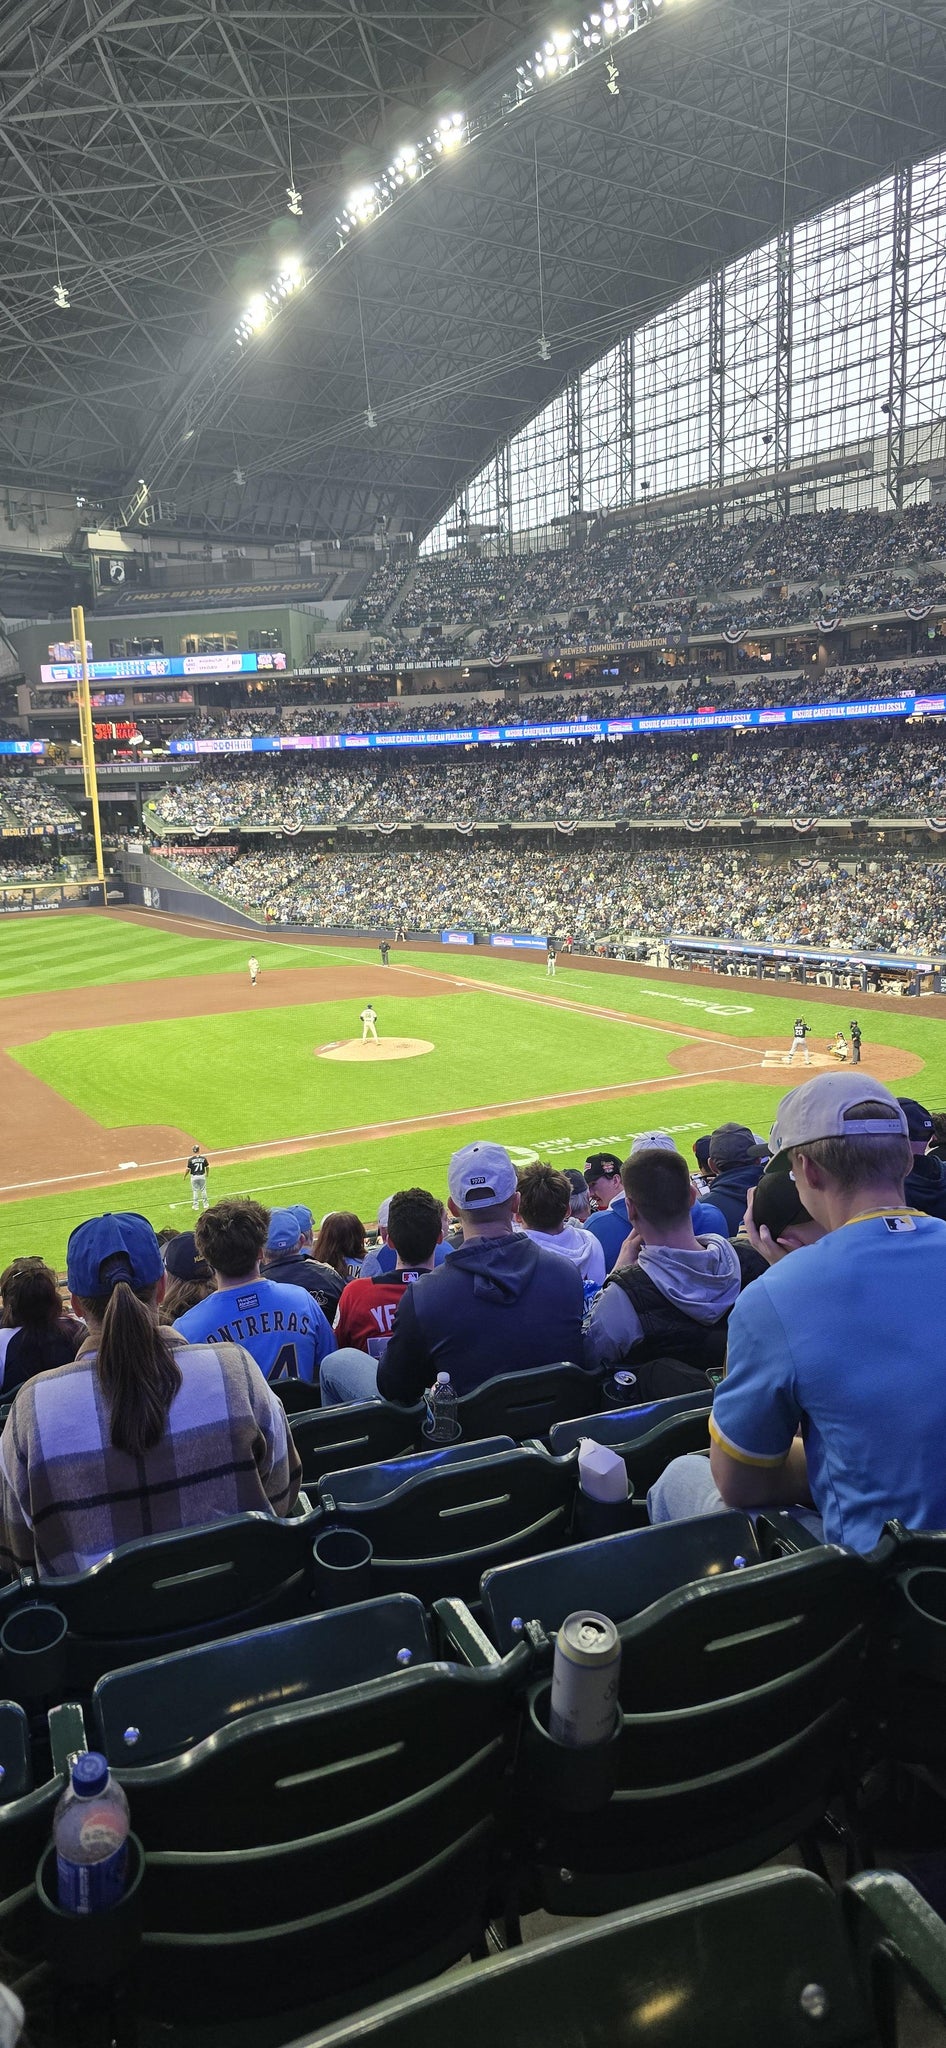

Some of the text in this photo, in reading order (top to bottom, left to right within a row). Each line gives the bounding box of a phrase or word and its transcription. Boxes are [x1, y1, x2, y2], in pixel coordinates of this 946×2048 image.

[133, 592, 170, 601] MUST
[190, 589, 205, 597] IN
[208, 588, 234, 596] THE
[234, 584, 280, 594] FRONT
[281, 582, 320, 591] ROW!
[560, 637, 668, 656] BREWERS COMMUNITY FOUNDATION
[792, 709, 813, 719] INSURE
[814, 706, 846, 717] CAREFULLY,
[846, 704, 867, 715] DREAM
[868, 701, 906, 713] FEARLESSLY.
[639, 720, 660, 729] INSURE
[660, 717, 693, 728] CAREFULLY,
[694, 715, 714, 726] DREAM
[714, 713, 752, 725] FEARLESSLY.
[505, 729, 523, 738] INSURE
[552, 725, 569, 735] DREAM
[2, 826, 44, 837] NICOLET LAW
[546, 1134, 625, 1155] credit
[194, 1163, 203, 1172] 71
[370, 1303, 396, 1332] YE
[206, 1311, 310, 1344] ONTRERAS
[267, 1343, 300, 1381] 4
